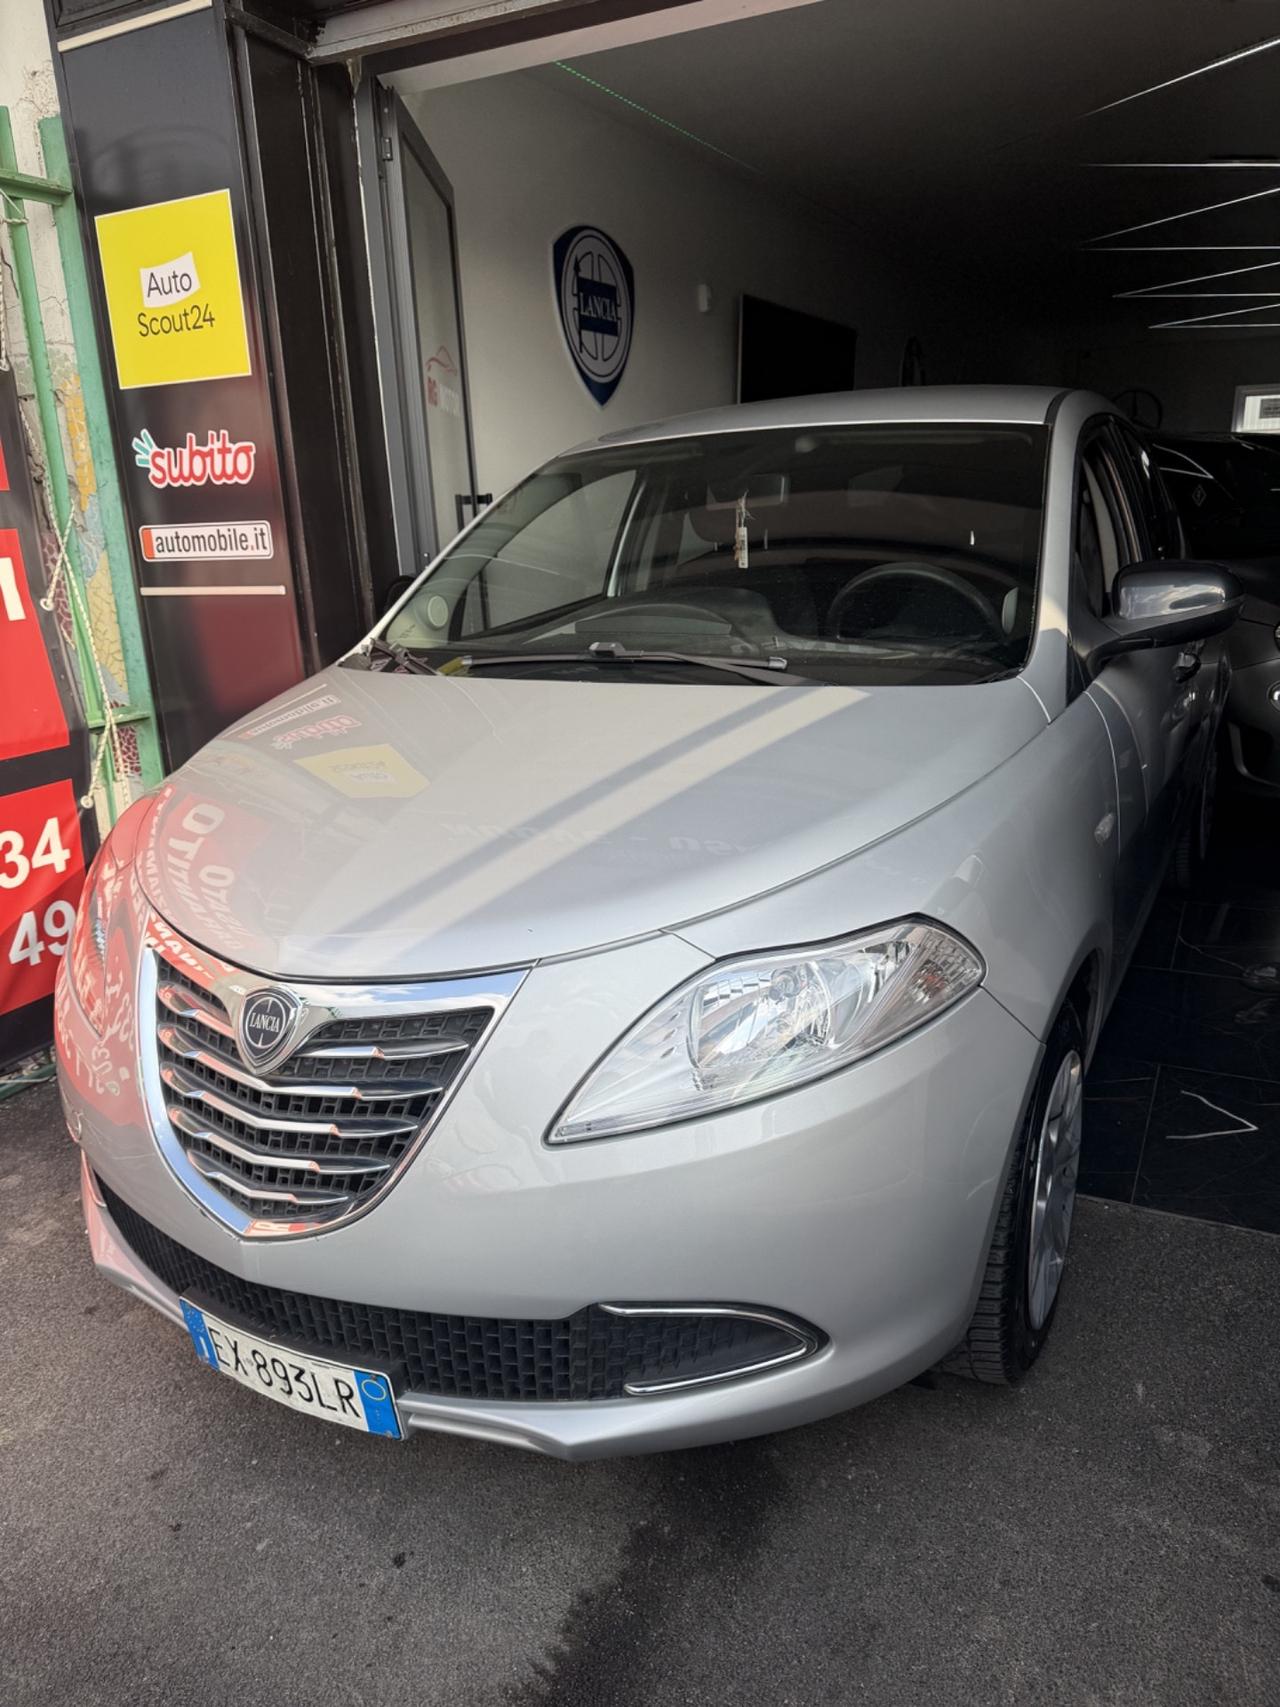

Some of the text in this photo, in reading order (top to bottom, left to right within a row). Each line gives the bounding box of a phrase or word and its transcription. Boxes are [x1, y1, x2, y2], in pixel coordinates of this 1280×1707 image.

[146, 267, 193, 298] Auto
[137, 303, 216, 337] Scout24
[579, 292, 618, 321] LANCIA
[150, 431, 254, 484] subito
[155, 528, 268, 554] automobile.it
[249, 1012, 281, 1034] LANCIA
